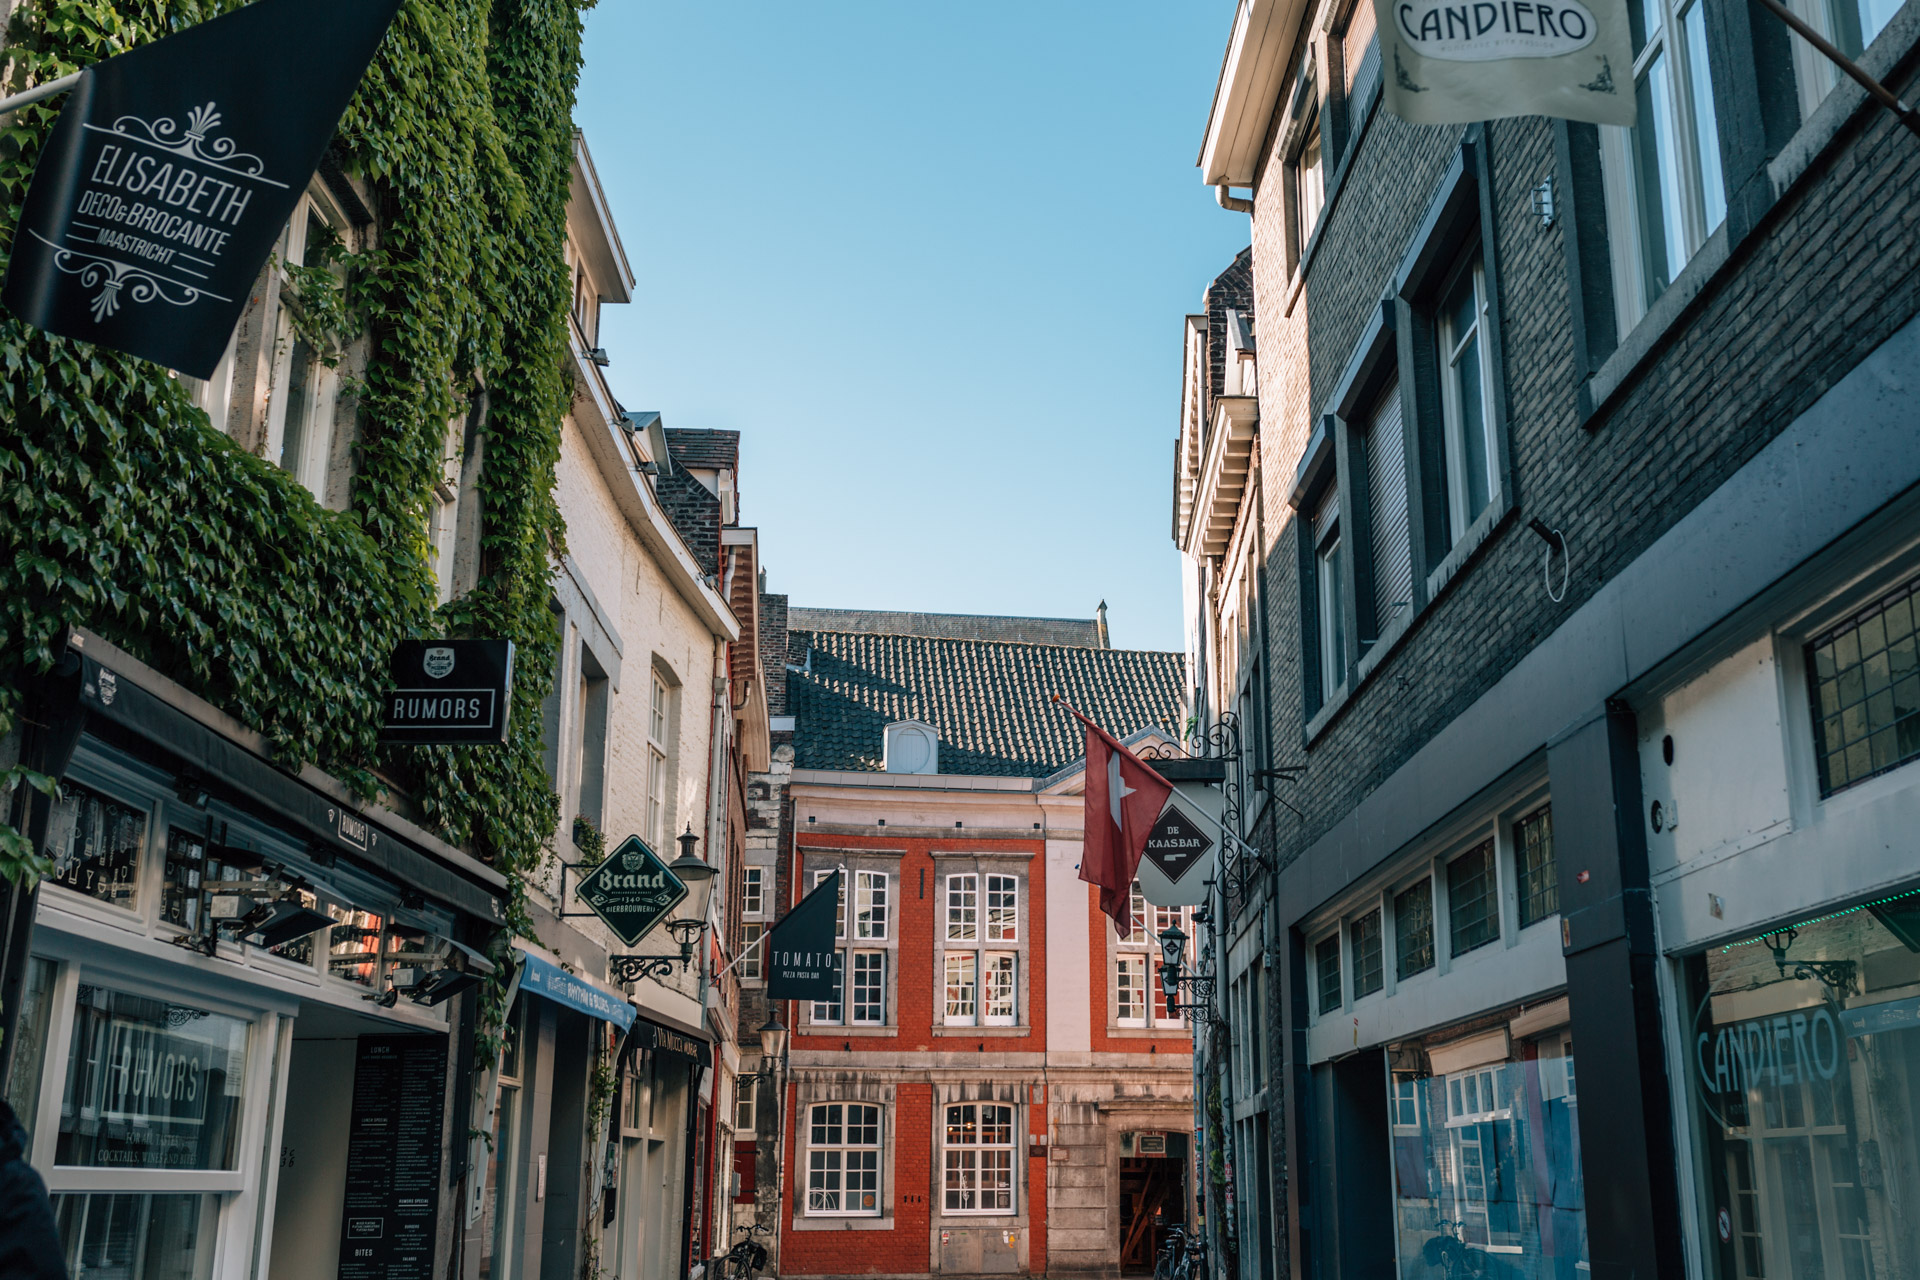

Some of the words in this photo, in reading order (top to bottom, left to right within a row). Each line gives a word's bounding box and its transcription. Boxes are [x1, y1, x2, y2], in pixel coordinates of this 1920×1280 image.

[1400, 1, 1587, 41] CANDIERO
[91, 144, 253, 226] ELISABETH
[96, 228, 177, 265] MAASTRICHT
[393, 698, 480, 719] RUMORS
[342, 814, 365, 842] RUMORS
[1167, 826, 1180, 835] DE
[1148, 839, 1201, 848] KAASBAR
[599, 868, 665, 891] Brand
[606, 904, 656, 913] BIERBROUWERIJ
[622, 896, 640, 904] 1340
[773, 951, 832, 968] TOMATO
[782, 970, 796, 979] PIZZA
[796, 971, 810, 979] PASTA
[1697, 1009, 1838, 1094] CANDIERO
[118, 1046, 199, 1102] RUMORS
[126, 1132, 141, 1144] FOR
[354, 1248, 373, 1257] BITES
